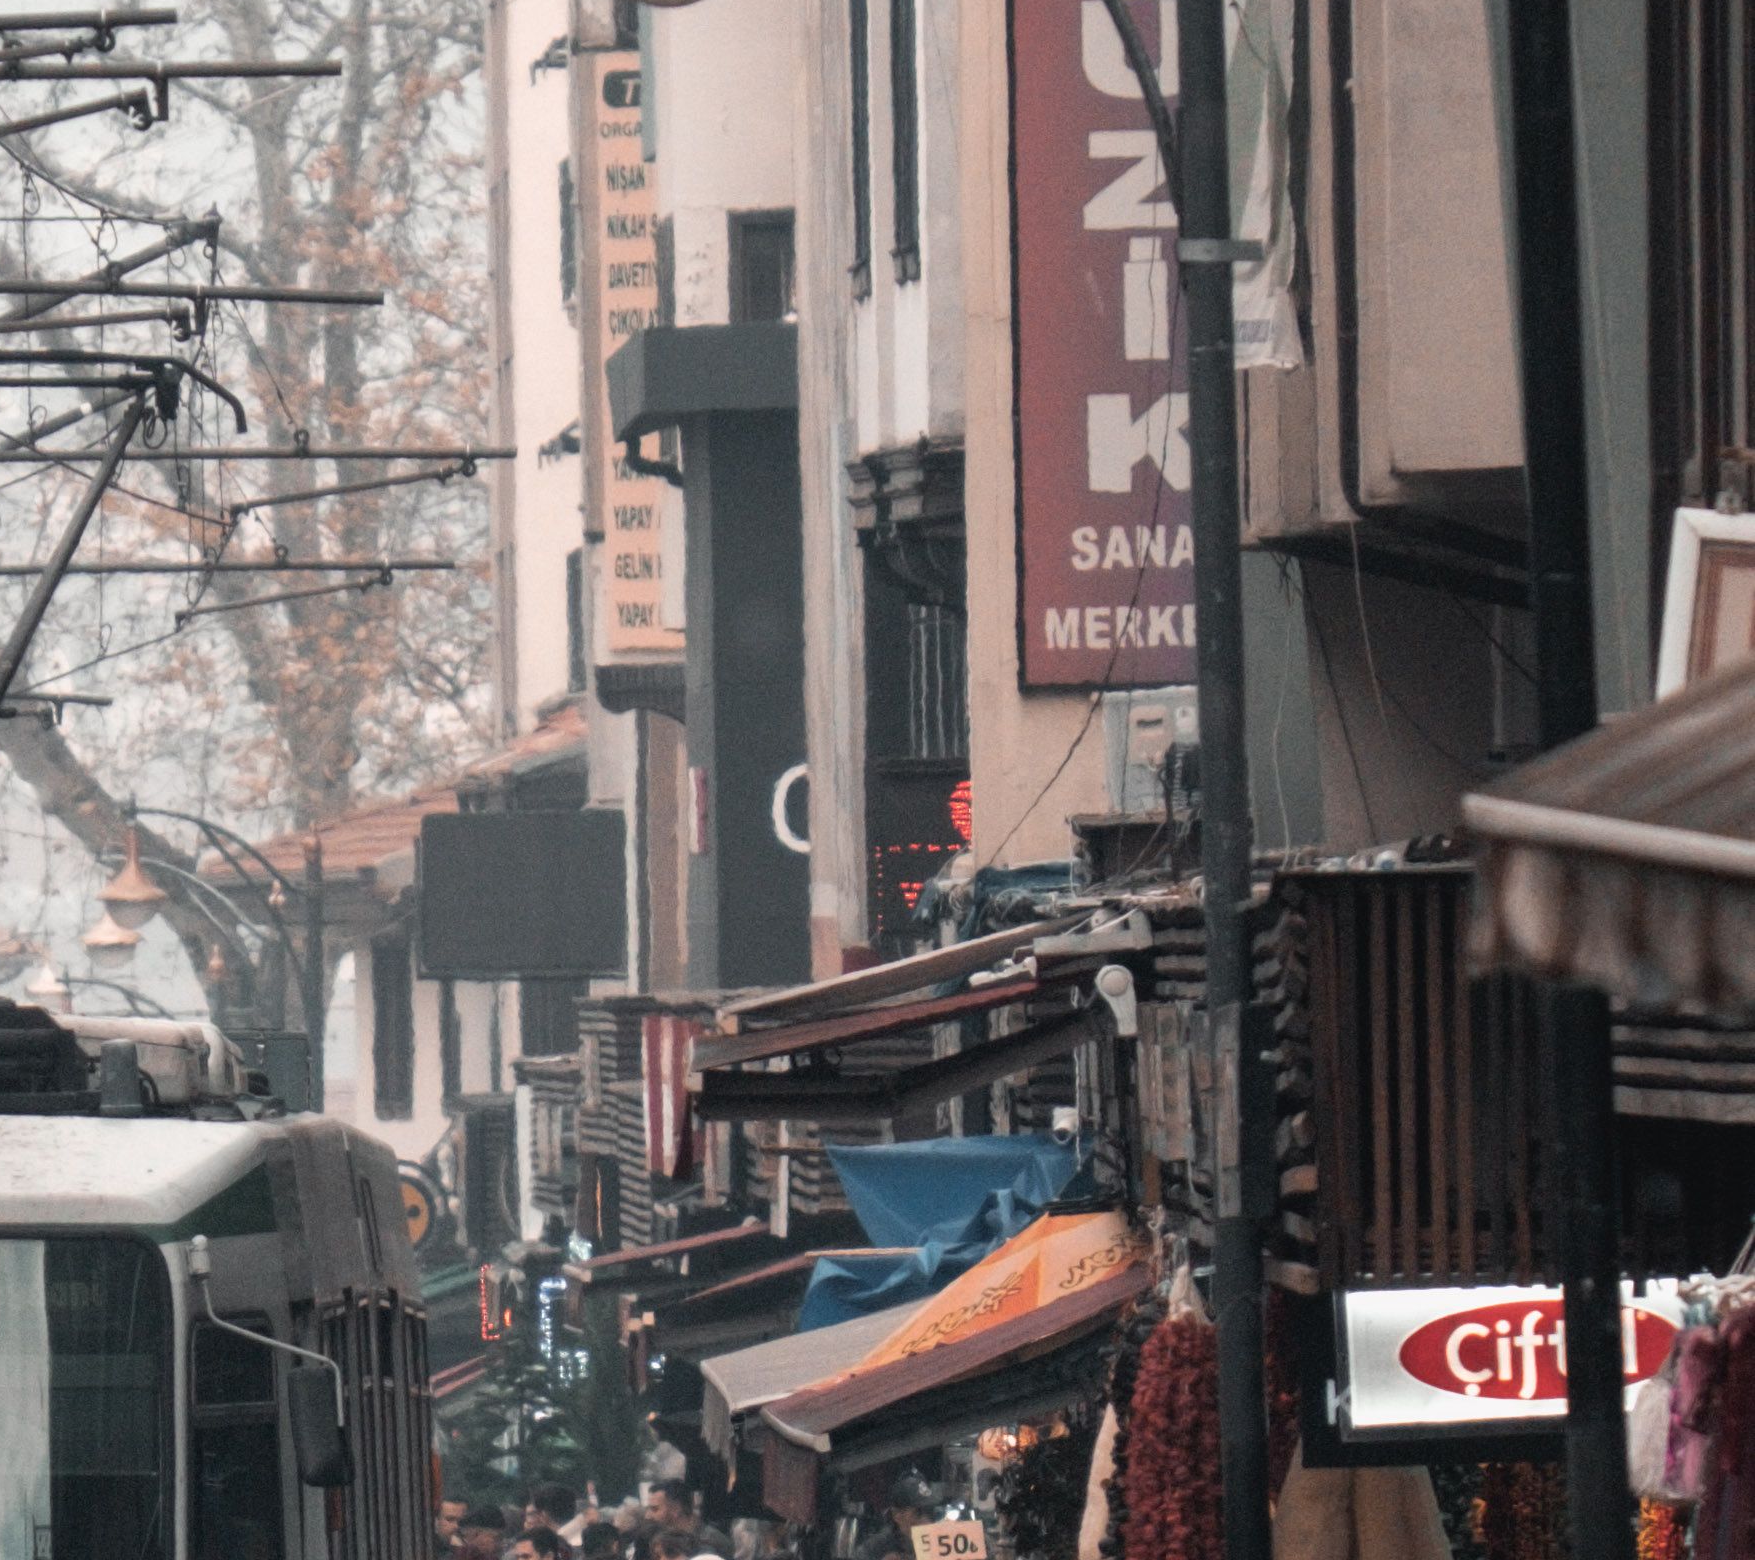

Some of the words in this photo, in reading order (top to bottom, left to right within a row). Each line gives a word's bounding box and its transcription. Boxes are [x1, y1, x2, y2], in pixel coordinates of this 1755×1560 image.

[599, 121, 643, 138] ORGA
[614, 505, 653, 530] YAPAY
[1071, 525, 1195, 571] SANA
[614, 547, 653, 579] GELİN
[616, 603, 654, 628] YAPAY
[1445, 1307, 1639, 1400] Çiftl
